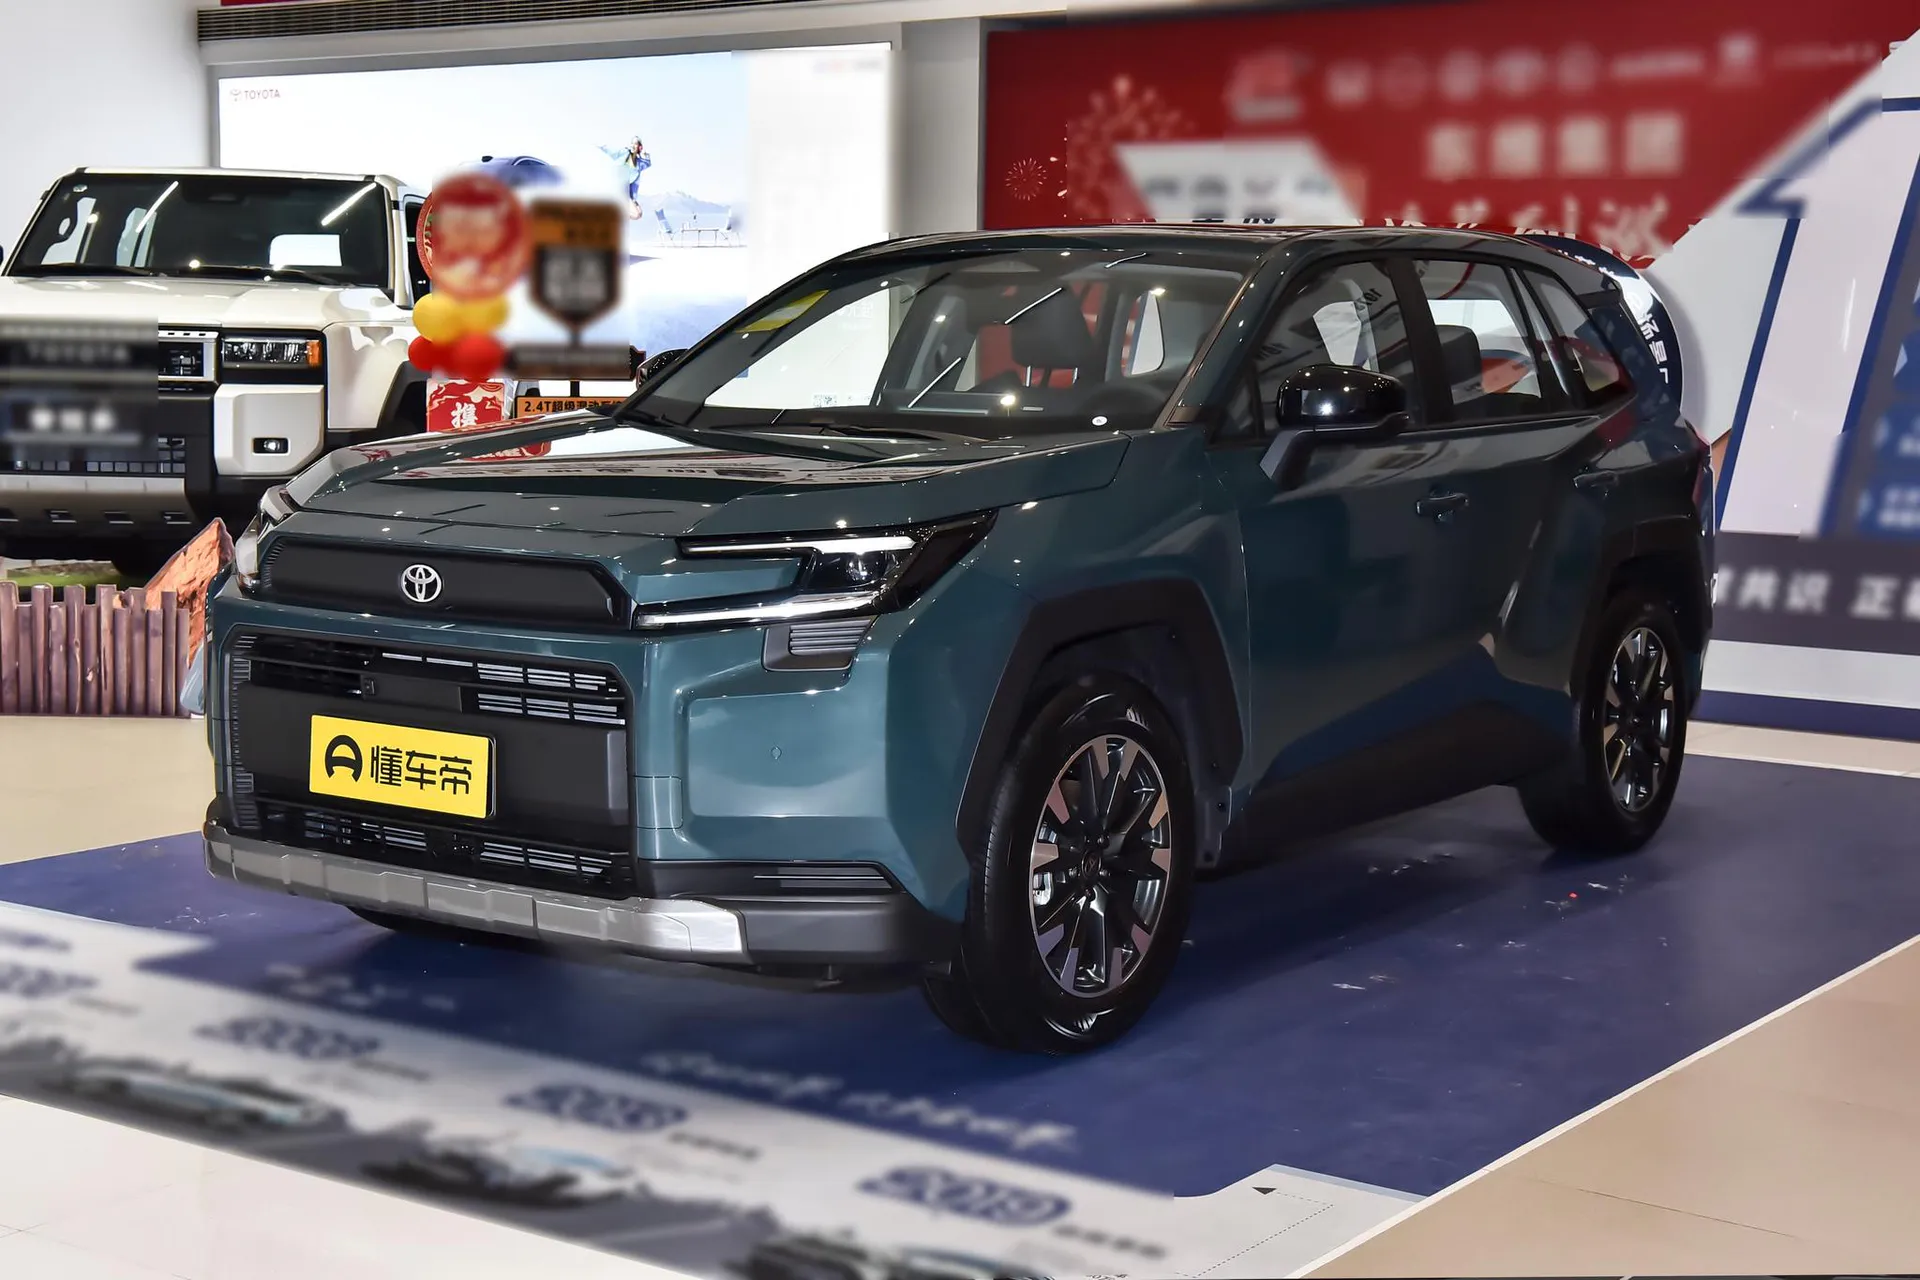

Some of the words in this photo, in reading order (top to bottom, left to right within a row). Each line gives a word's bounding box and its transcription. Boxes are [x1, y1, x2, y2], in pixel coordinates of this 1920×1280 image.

[244, 89, 281, 100] TOYOTA
[371, 745, 472, 795] 懂车帝
